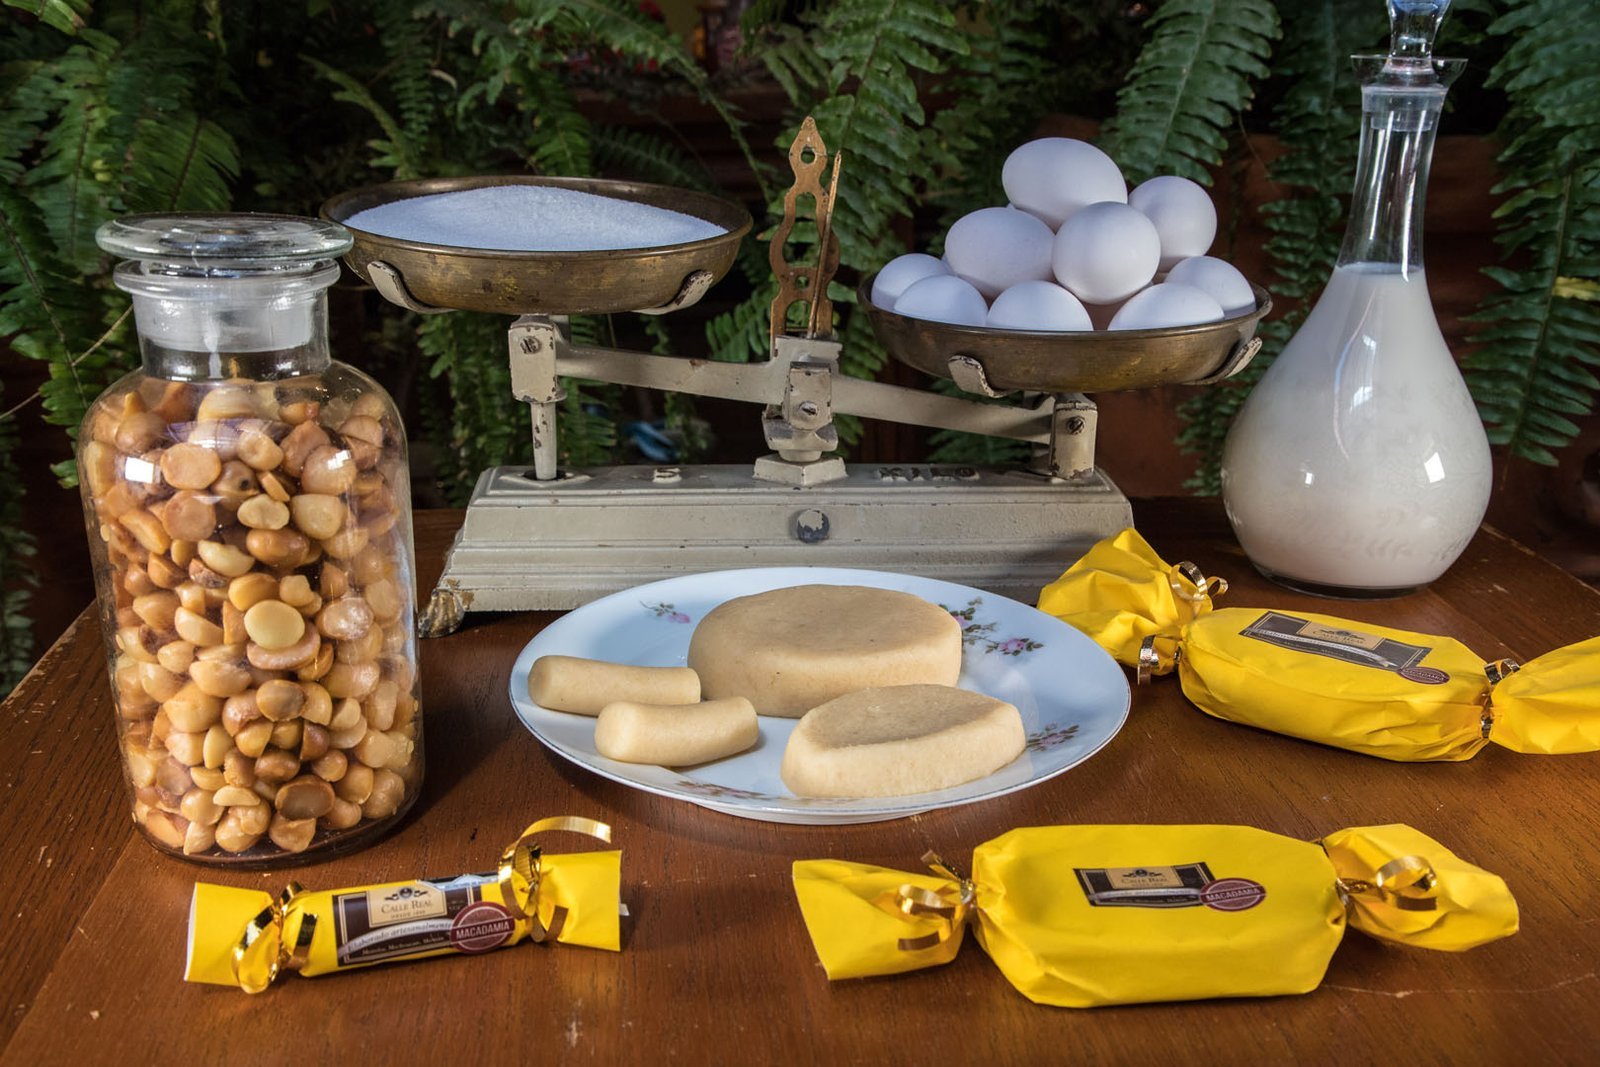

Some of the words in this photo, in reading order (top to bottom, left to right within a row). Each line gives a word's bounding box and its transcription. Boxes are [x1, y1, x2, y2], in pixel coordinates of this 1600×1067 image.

[879, 466, 979, 481] KILO
[1206, 887, 1260, 900] MACADAMIA
[381, 903, 409, 914] CALLE
[412, 900, 433, 910] REAL
[456, 920, 510, 940] MACADAMIA
